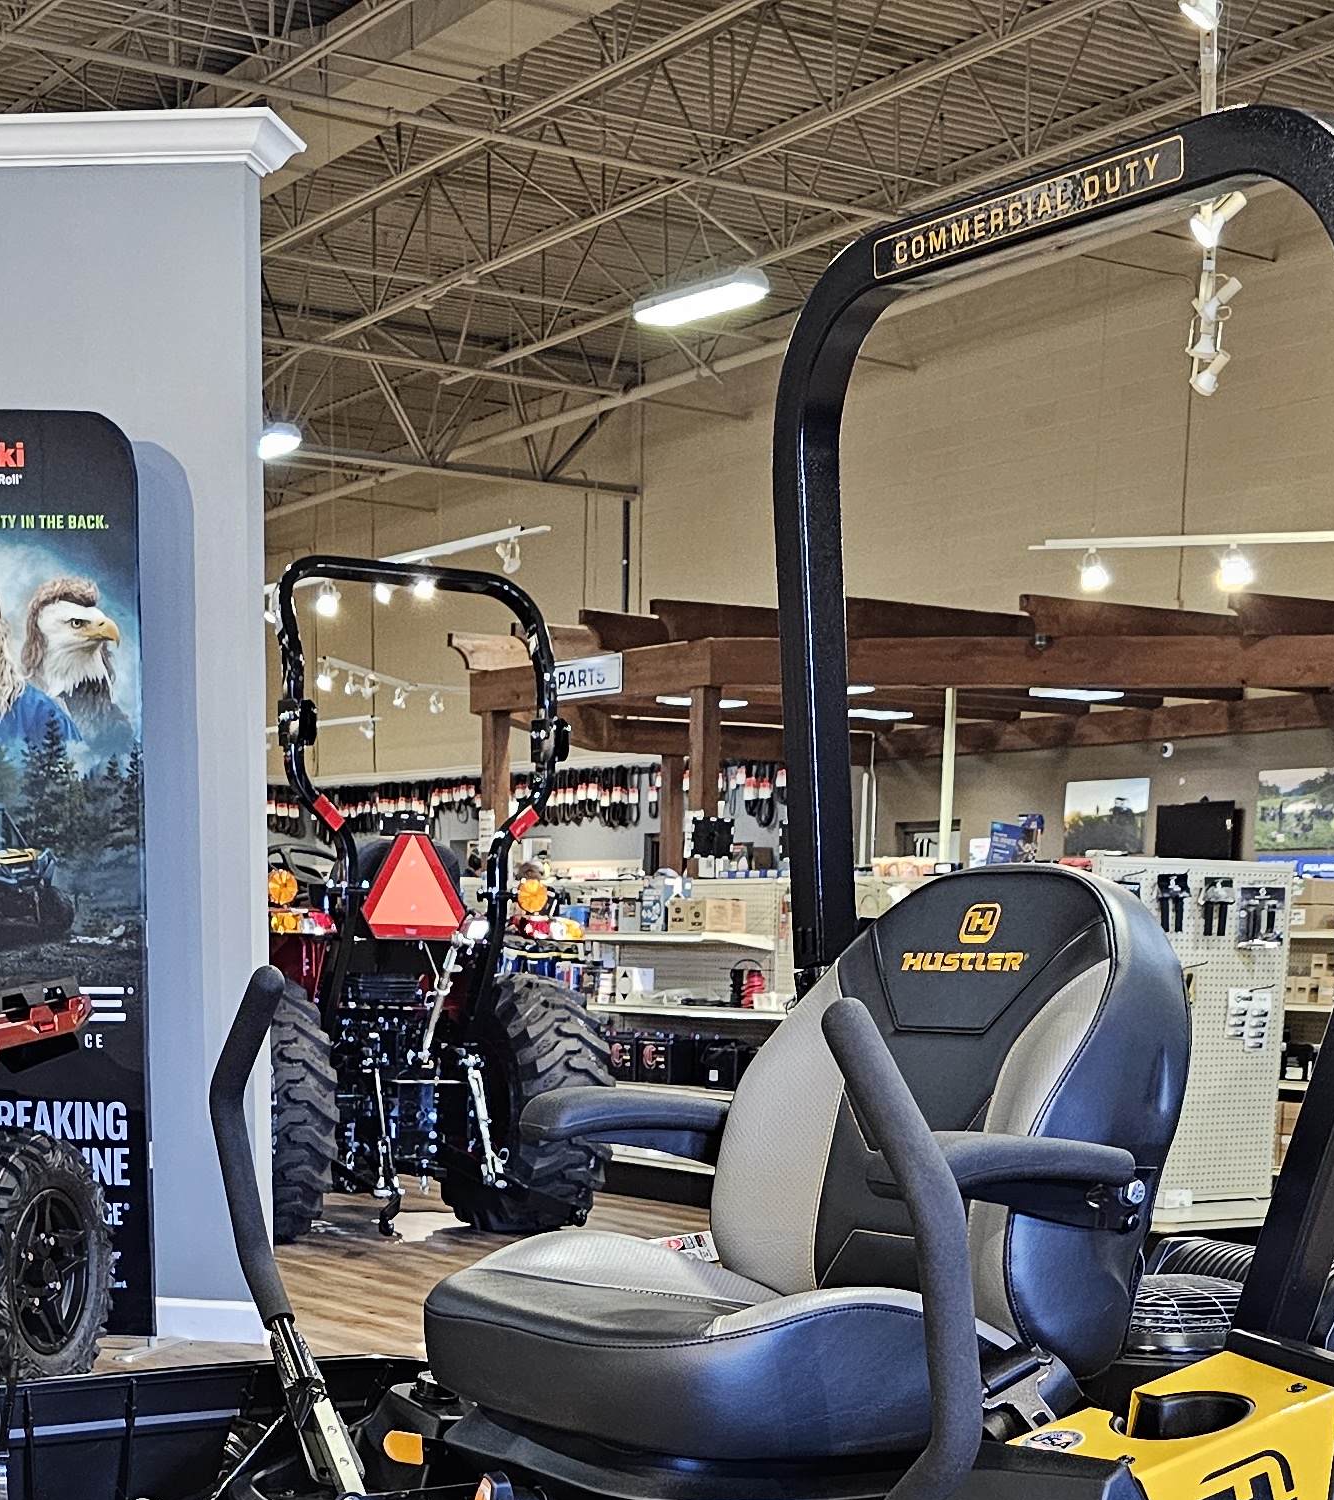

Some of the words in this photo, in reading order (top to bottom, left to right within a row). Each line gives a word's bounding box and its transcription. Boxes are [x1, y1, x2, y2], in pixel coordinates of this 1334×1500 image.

[895, 189, 1069, 265] COMMERCIAL
[1084, 153, 1160, 202] DUTY
[20, 515, 35, 530] IN
[38, 515, 65, 530] THE
[68, 515, 110, 530] BACK.
[558, 667, 606, 690] PARTS
[901, 952, 1025, 972] HUSTLER
